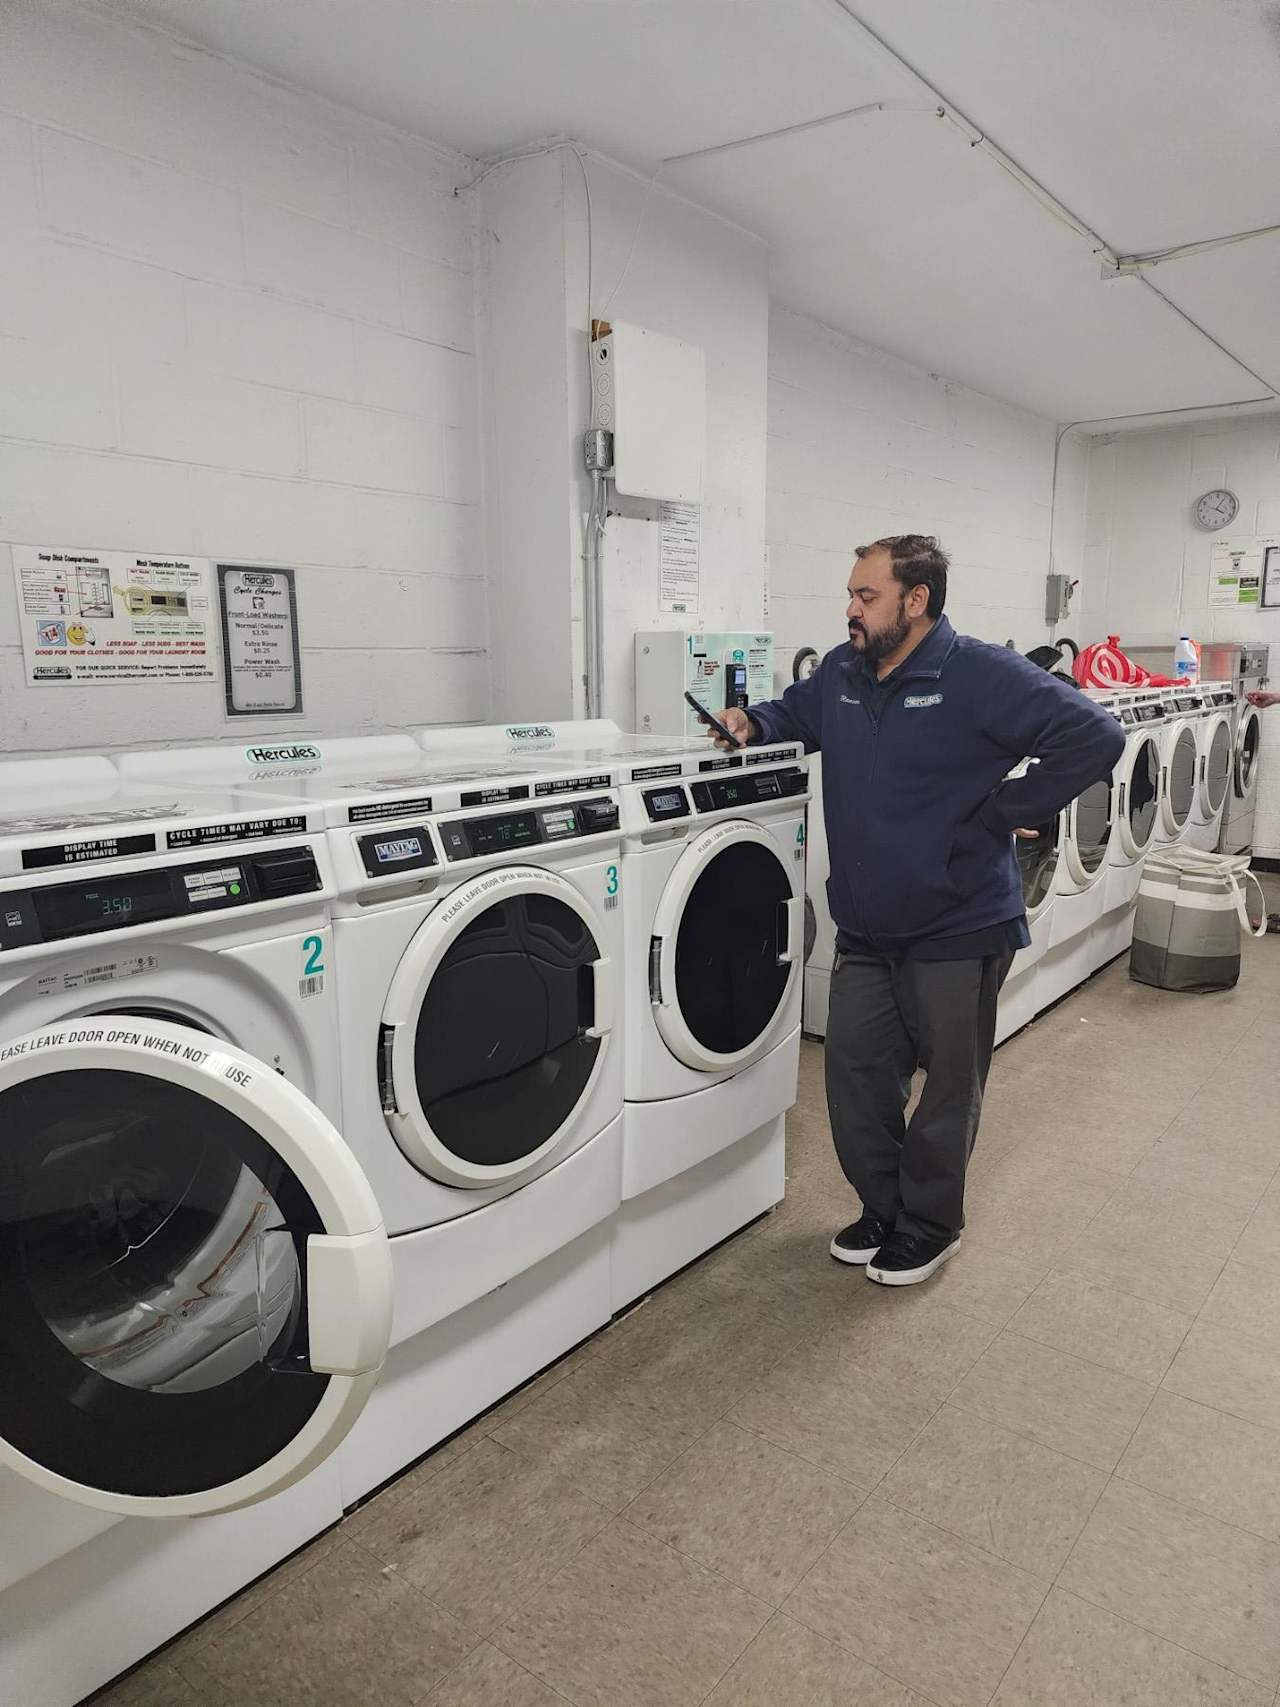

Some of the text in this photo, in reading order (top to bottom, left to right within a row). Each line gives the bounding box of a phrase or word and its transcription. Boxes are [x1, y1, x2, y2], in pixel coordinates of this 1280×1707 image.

[244, 573, 273, 586] Hercules
[37, 665, 69, 674] Hercules
[508, 727, 552, 739] Hercules
[252, 746, 316, 761] Hercules
[170, 829, 197, 840] CYCLE
[201, 825, 227, 836] TIMES
[229, 823, 246, 833] MAY
[249, 820, 269, 830] VARY
[272, 818, 287, 828] DUE
[796, 823, 804, 846] 4
[64, 839, 118, 853] DISPLAY TIME
[64, 847, 119, 862] IS ESTIMATED
[379, 840, 418, 856] MAYTAG
[607, 865, 618, 895] 3
[103, 896, 131, 915] 3.50
[441, 900, 465, 923] PLEASE
[462, 886, 484, 904] LEAVE
[303, 936, 324, 975] 2
[30, 1033, 66, 1050] LEAVE
[68, 1030, 104, 1044] DOOR
[106, 1030, 142, 1046] OPEN
[143, 1035, 182, 1056] WHEN
[182, 1046, 209, 1065] NOT
[225, 1065, 252, 1088] USE
